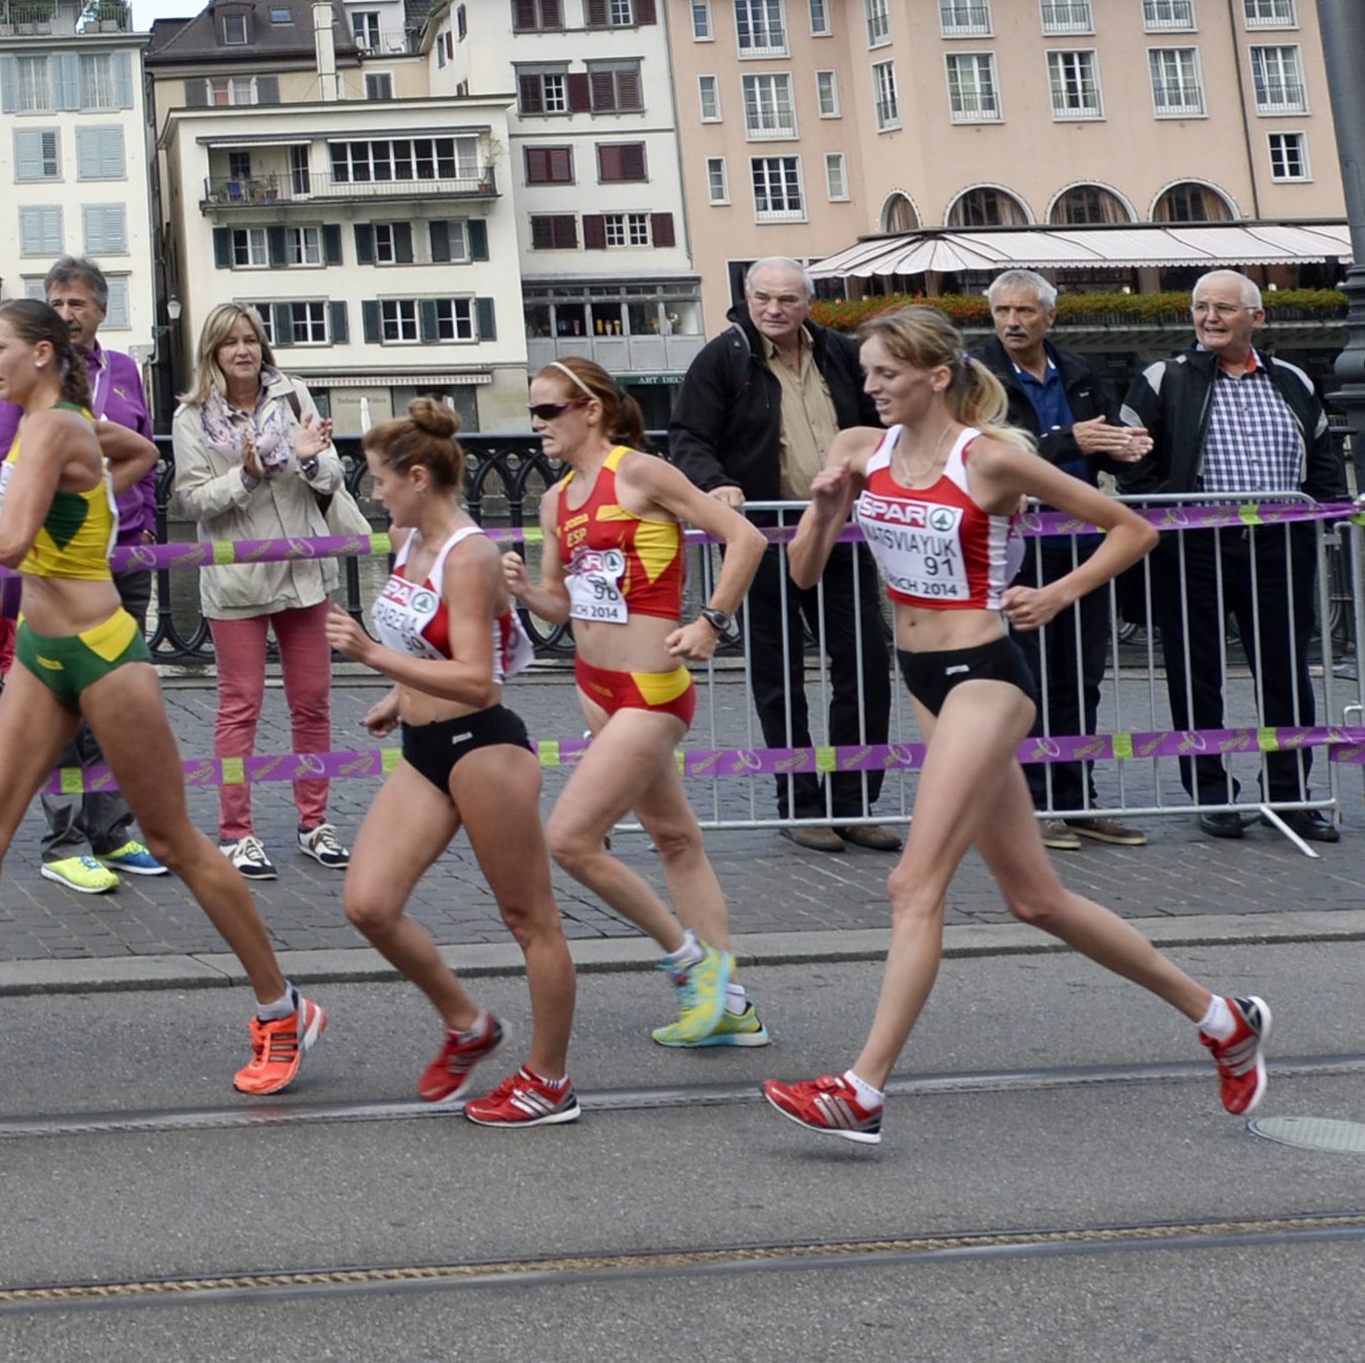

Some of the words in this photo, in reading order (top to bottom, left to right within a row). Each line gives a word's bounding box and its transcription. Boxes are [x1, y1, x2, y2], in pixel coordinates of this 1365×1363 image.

[860, 496, 926, 524] SPAR
[924, 556, 954, 577] 91
[924, 581, 958, 596] 2014
[591, 606, 619, 618] 2014
